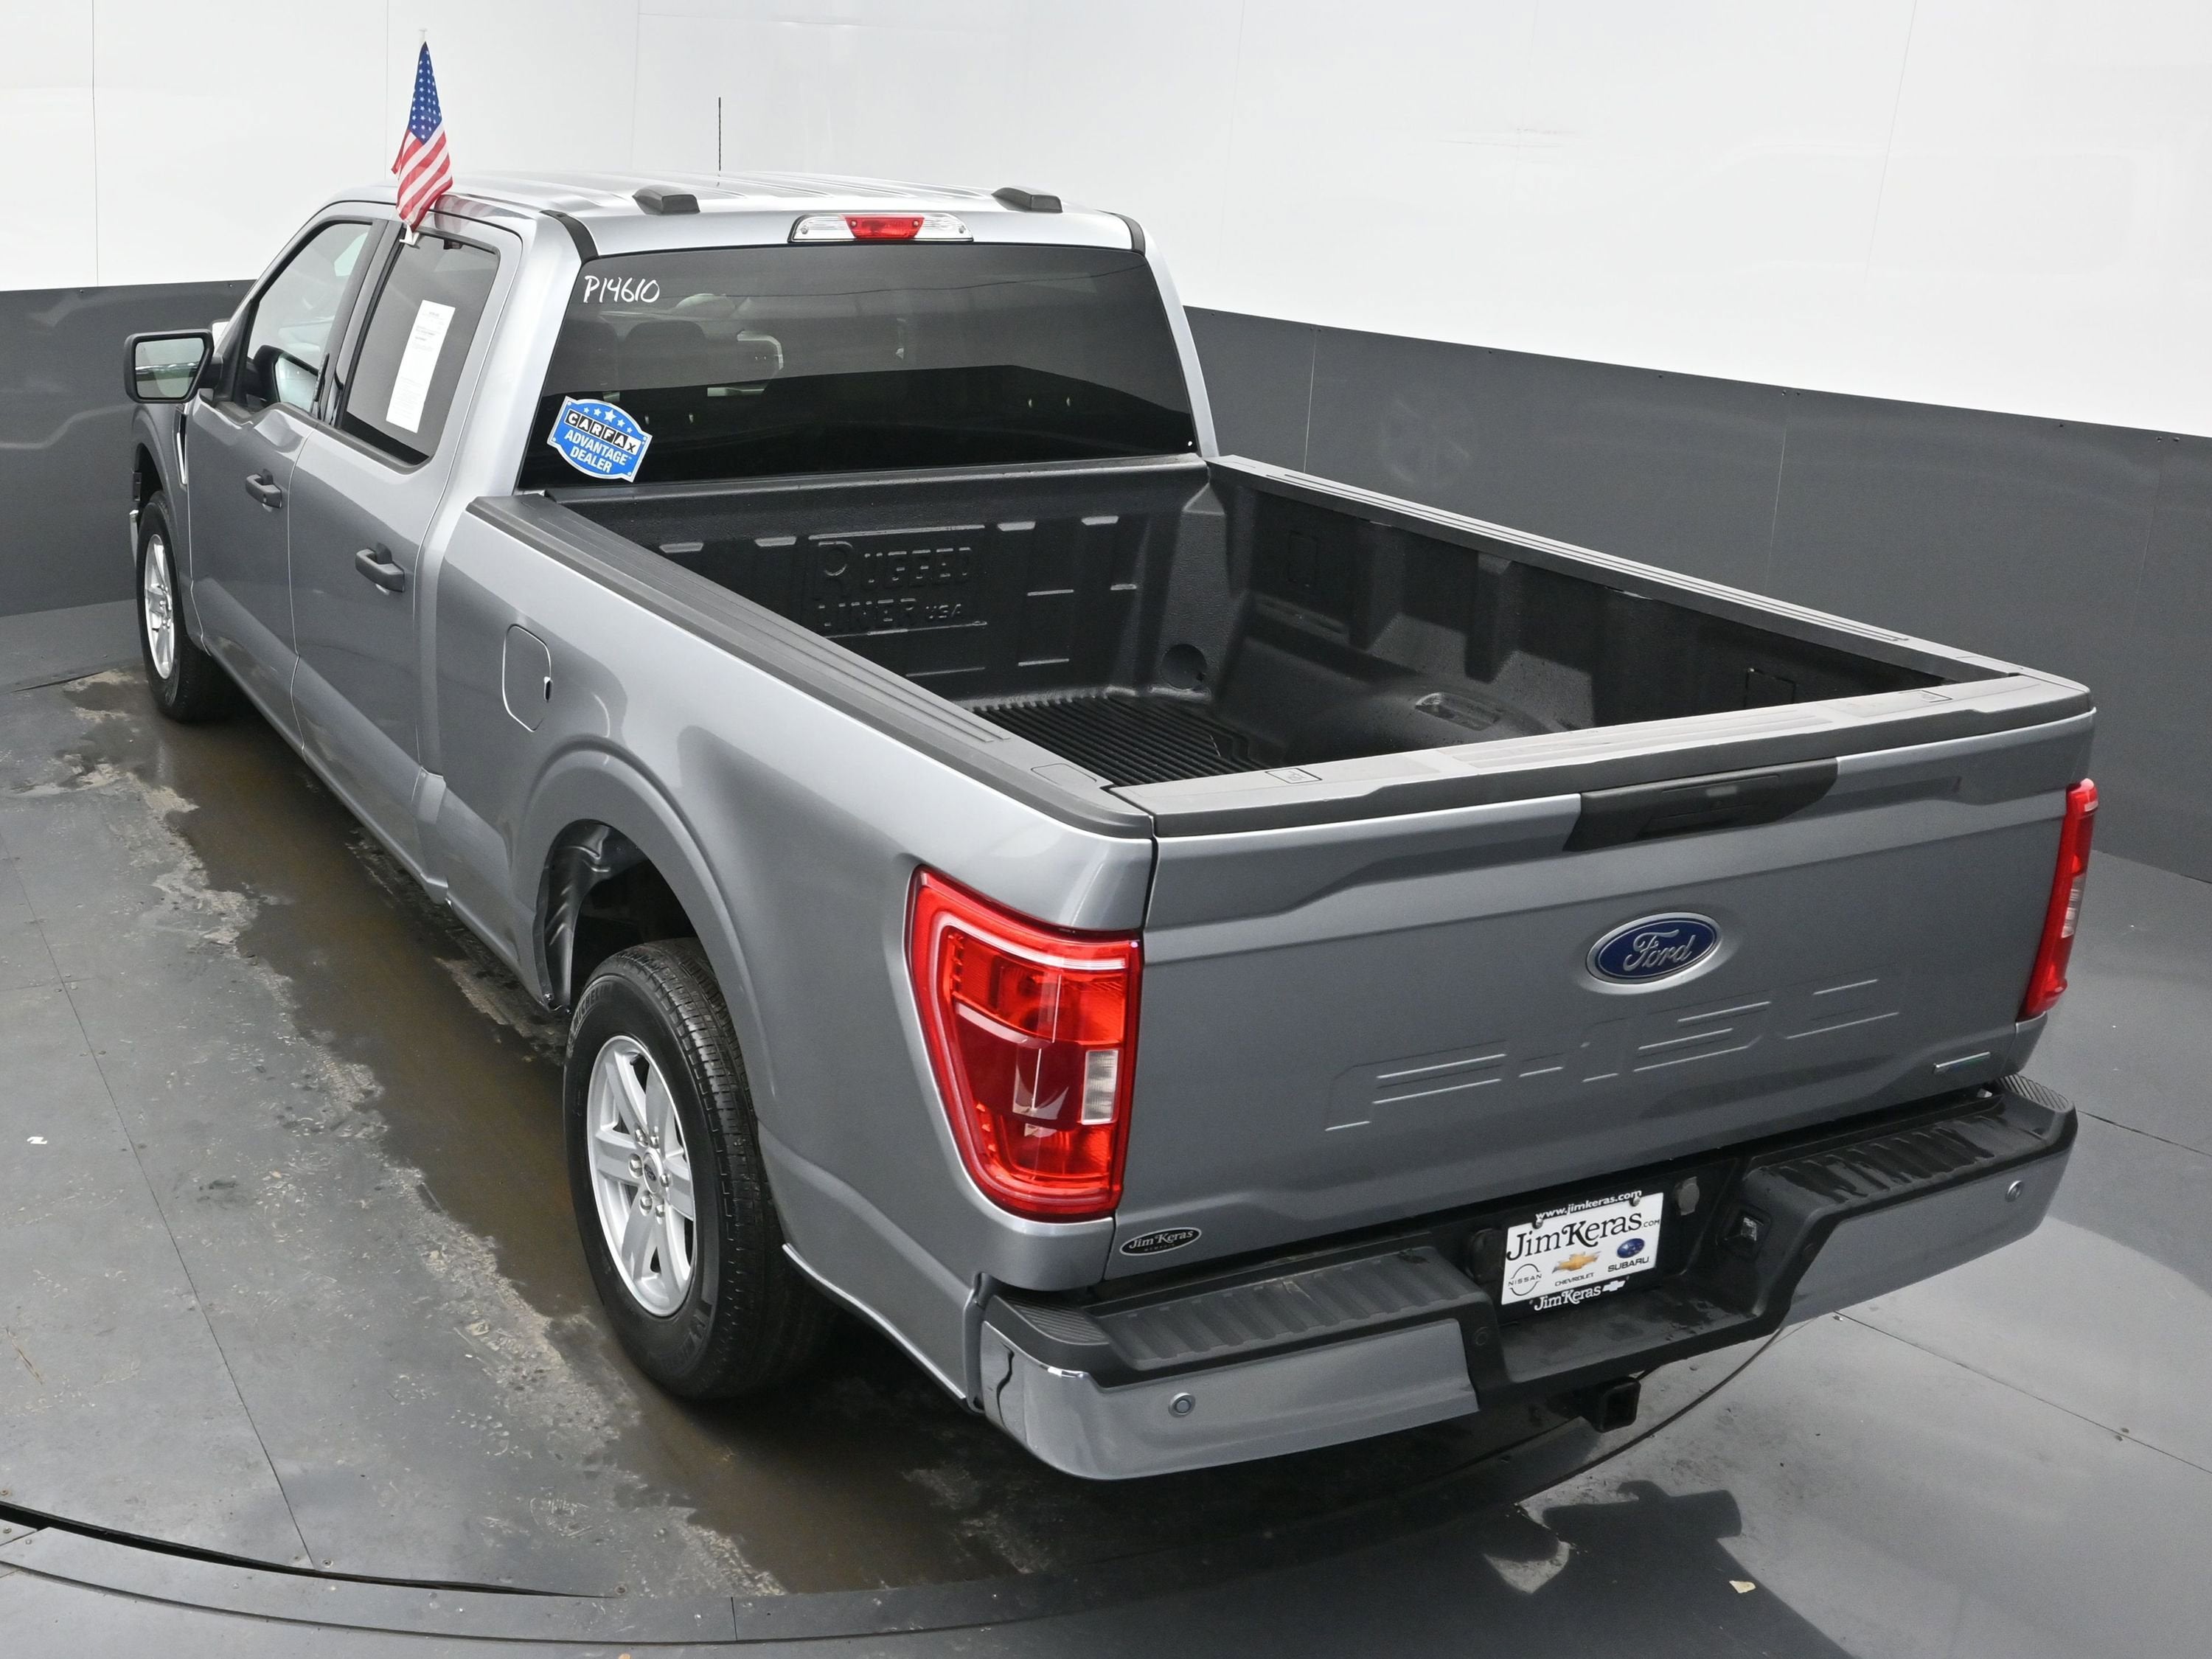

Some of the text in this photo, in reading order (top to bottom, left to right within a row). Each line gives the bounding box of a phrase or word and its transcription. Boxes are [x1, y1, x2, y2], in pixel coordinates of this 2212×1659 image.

[583, 275, 660, 304] P14610
[564, 429, 627, 466] ADVANTAGE
[565, 410, 641, 456] CARFAX
[570, 448, 613, 473] DEALER
[1623, 929, 1696, 971] Ford
[1535, 1189, 1642, 1220] www.jimkeras.com
[1607, 1256, 1649, 1273] SUBARU
[1508, 1273, 1542, 1286] NISSAN
[1554, 1272, 1594, 1287] CHEVROLET
